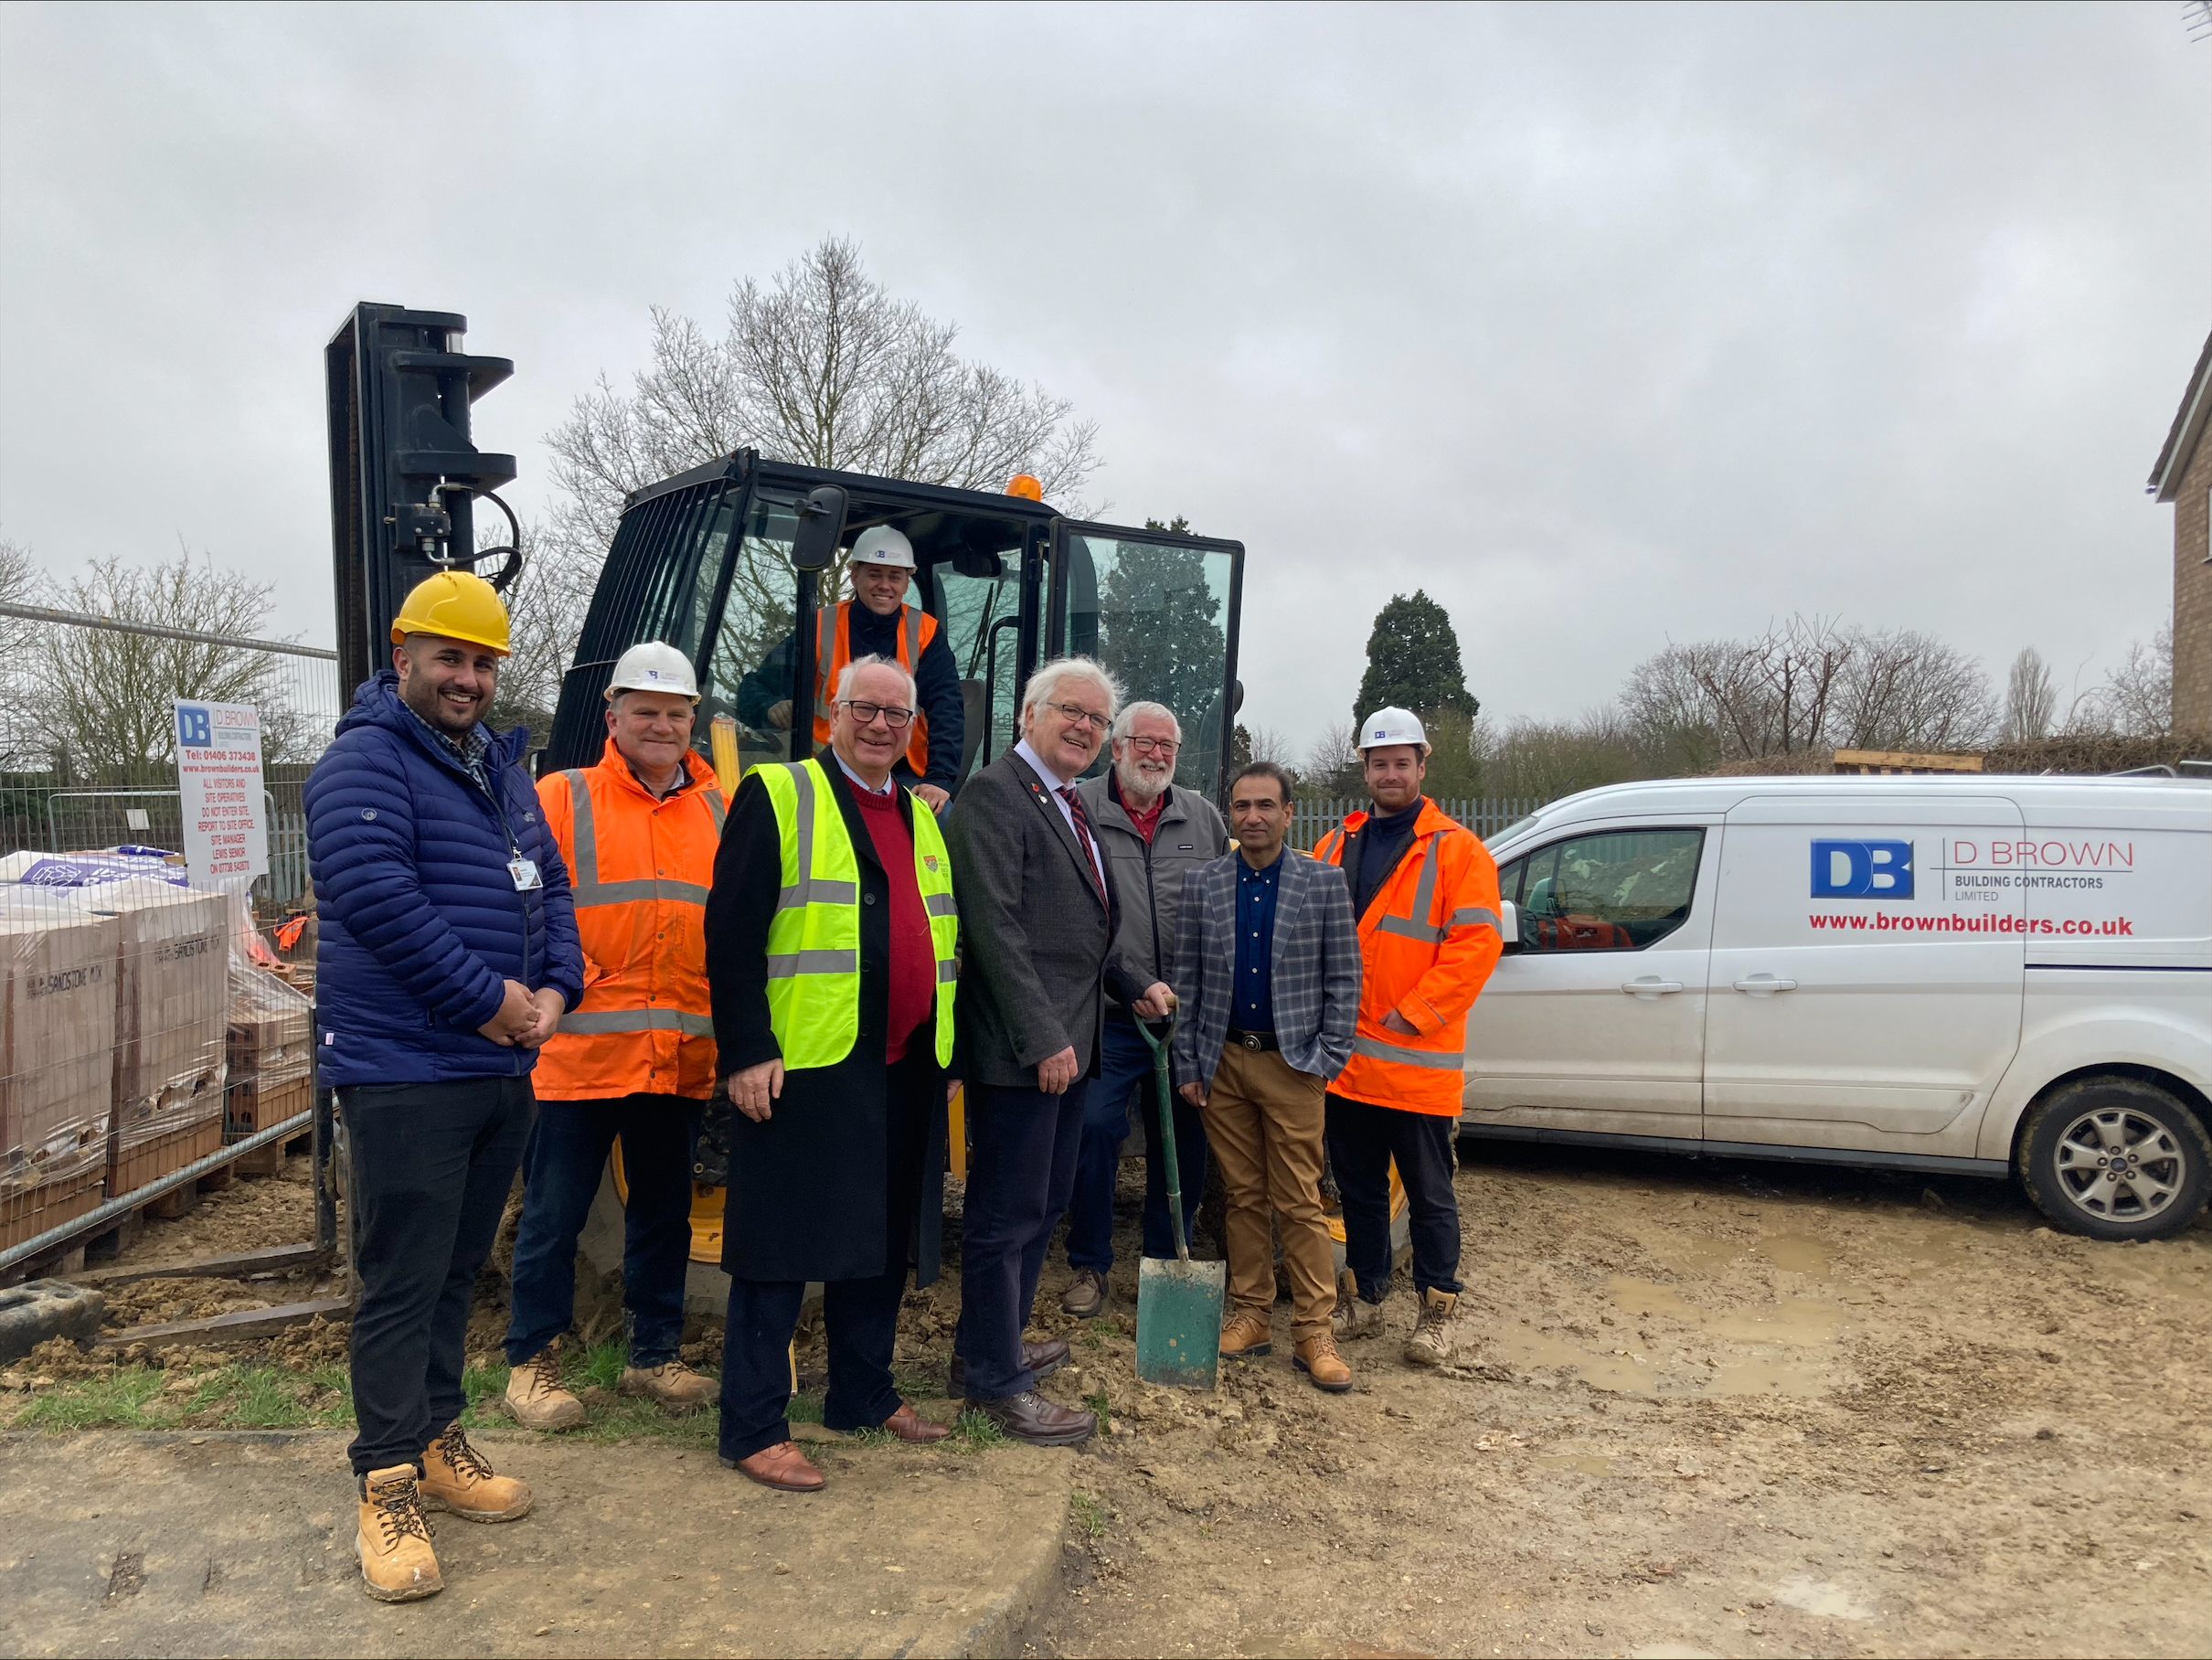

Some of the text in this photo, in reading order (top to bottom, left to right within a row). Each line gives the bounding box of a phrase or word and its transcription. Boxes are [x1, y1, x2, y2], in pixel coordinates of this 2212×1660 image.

[178, 706, 211, 747] DB
[186, 750, 256, 761] Tel: 01406 373438
[183, 764, 260, 773] www.brownbuilders.co.uk
[203, 778, 246, 789] ALL VISITORS AND
[205, 792, 246, 803] SITE OPERATIVES
[201, 807, 209, 817] DO
[210, 806, 221, 817] NOT
[222, 806, 238, 816] ENTER
[197, 821, 218, 832] REPORT
[218, 821, 226, 831] TO
[226, 820, 238, 831] SITE
[210, 833, 246, 846] SITE MANAGER
[212, 846, 246, 859] LEWIS SENIOR
[1954, 841, 2133, 867] D BROWN
[210, 864, 218, 874] ON
[1811, 838, 1915, 900] DB
[1955, 875, 2103, 889] BUILDING CONTRACTORS
[1955, 891, 1999, 901] LIMITED
[1809, 912, 2133, 936] www.brownbuilders.co.uk
